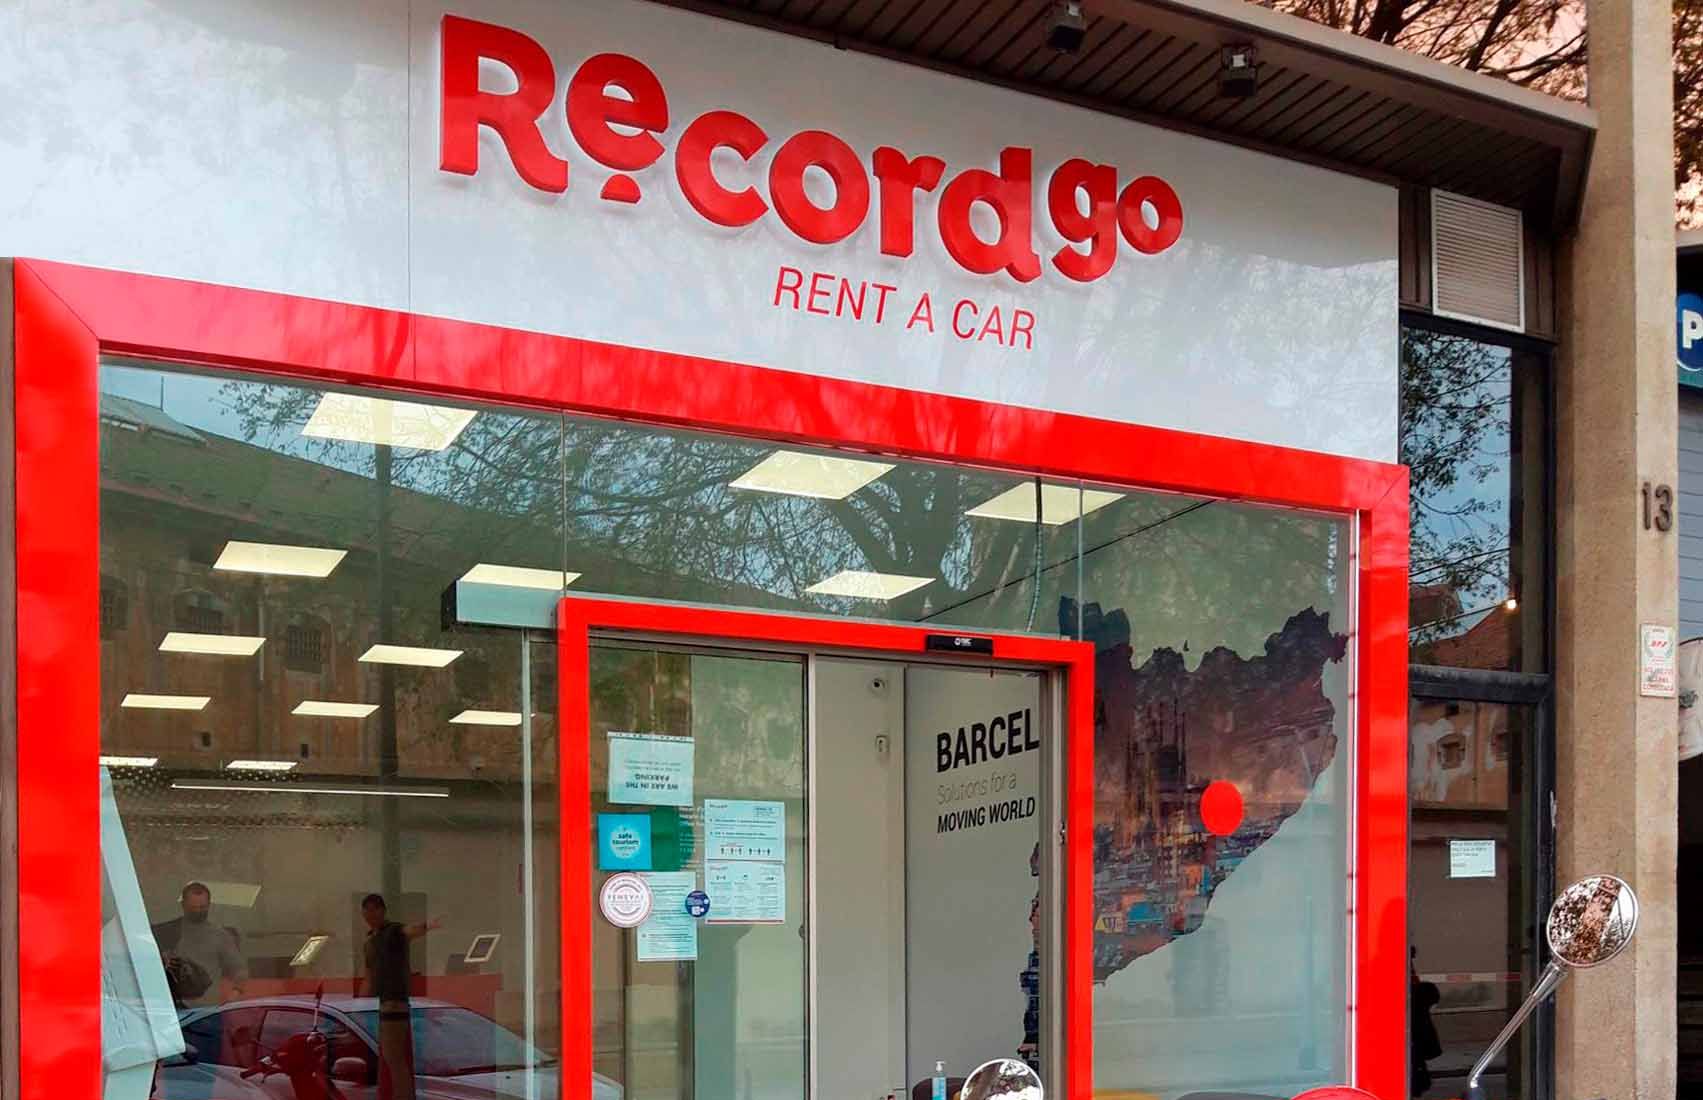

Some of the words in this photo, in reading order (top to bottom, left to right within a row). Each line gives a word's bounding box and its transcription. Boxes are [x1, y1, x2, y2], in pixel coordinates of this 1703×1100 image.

[773, 266, 897, 324] RENT
[906, 292, 935, 333] A
[952, 299, 1036, 350] CAR
[1682, 309, 1703, 349] P
[1642, 481, 1673, 532] 13
[936, 708, 1040, 773] BARCEL
[937, 778, 988, 805] Solutions
[991, 770, 1006, 794] for
[1008, 773, 1017, 790] a
[937, 806, 986, 833] MOVING
[989, 796, 1036, 824] WORLD
